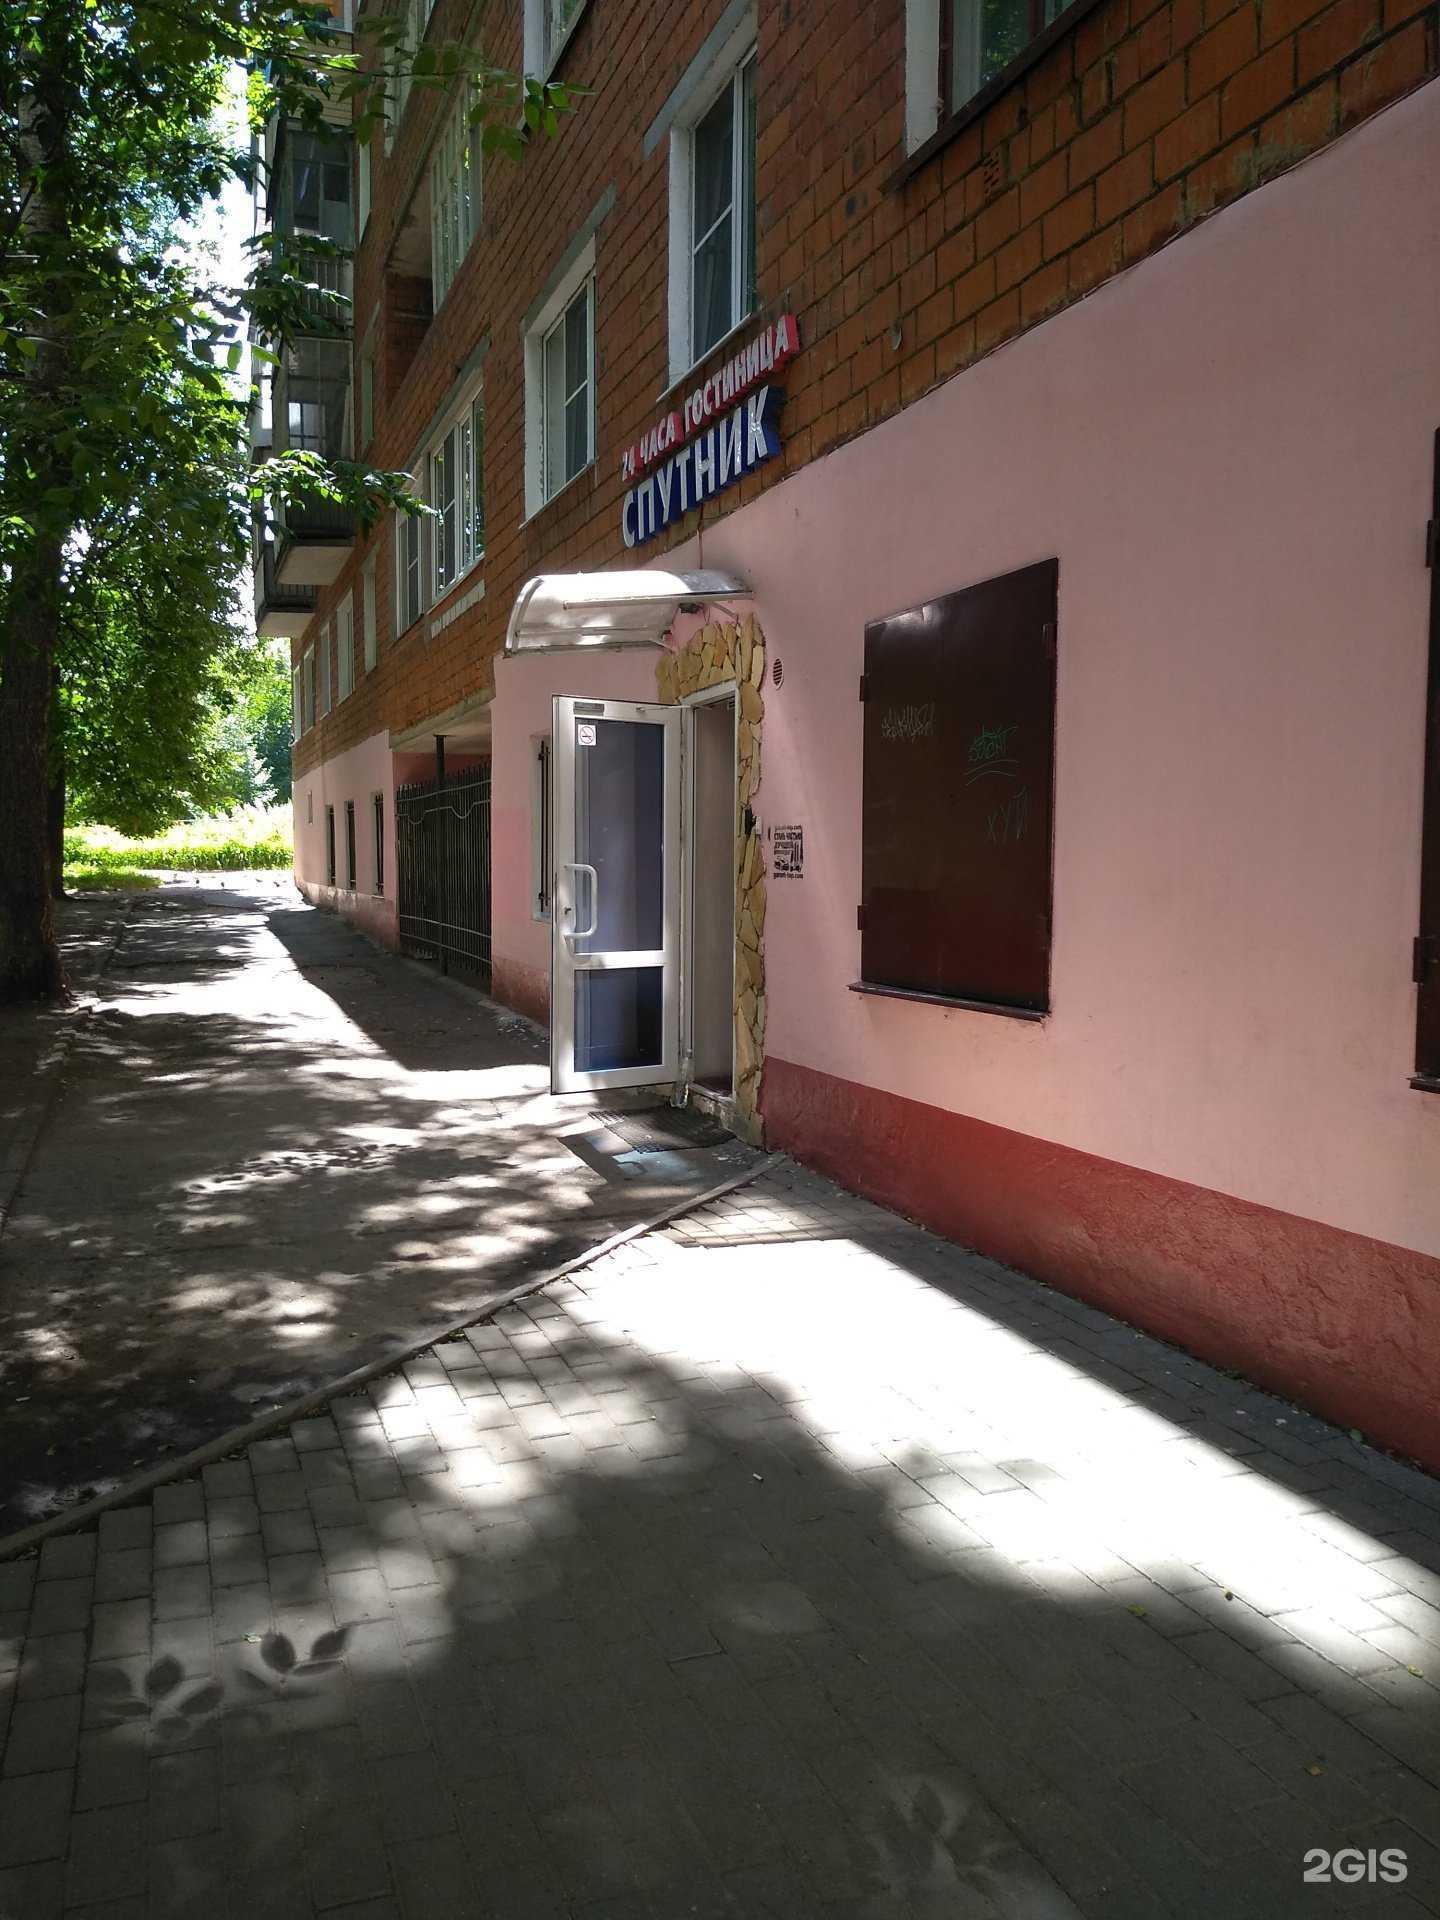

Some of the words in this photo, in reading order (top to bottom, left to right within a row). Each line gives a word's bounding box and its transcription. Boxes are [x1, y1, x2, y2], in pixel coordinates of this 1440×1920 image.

[622, 446, 635, 482] 24
[640, 414, 676, 464] ЧАСА
[685, 315, 789, 433] ГОСТИНИЦА
[622, 385, 769, 548] СПУТНИК
